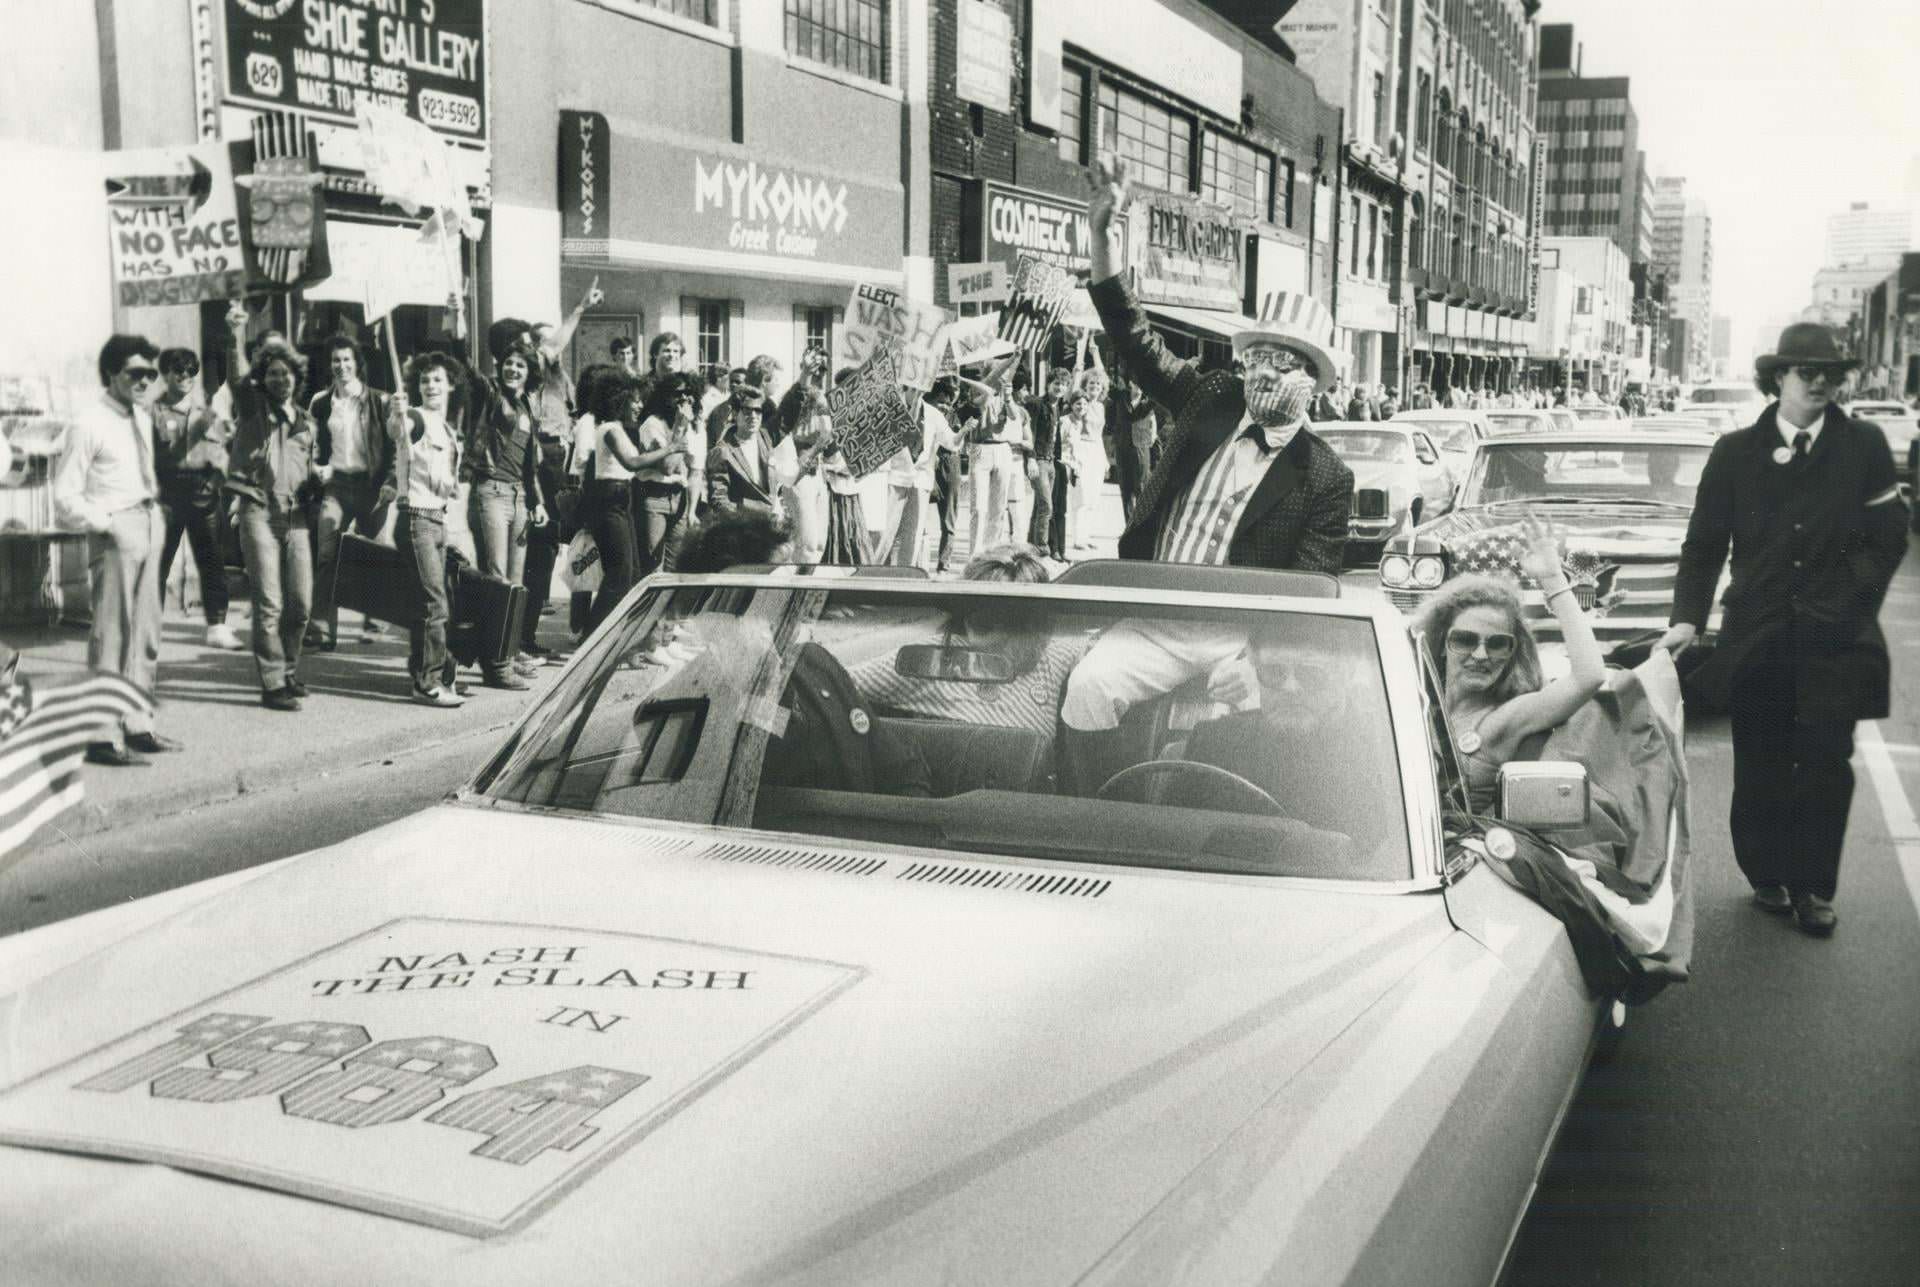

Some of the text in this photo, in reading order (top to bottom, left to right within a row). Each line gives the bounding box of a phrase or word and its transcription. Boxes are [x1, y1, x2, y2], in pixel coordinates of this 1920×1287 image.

[303, 1, 479, 82] SHOE GALLERY
[252, 61, 279, 90] 629
[293, 48, 408, 95] HAND MADE SHOES
[296, 77, 333, 108] MADE
[334, 85, 353, 112] TO
[579, 116, 595, 234] MYKONOS
[695, 156, 849, 234] MYKONOS
[112, 206, 186, 228] WITH
[990, 196, 1073, 254] COSMETIC
[119, 219, 240, 259] NO FACE
[729, 221, 770, 250] Greek
[121, 255, 229, 278] HAS NO
[858, 284, 899, 308] ELECT
[368, 947, 588, 973] NASH
[312, 967, 758, 997] THE SLASH
[537, 1005, 630, 1033] IN
[71, 1012, 652, 1166] 1984
